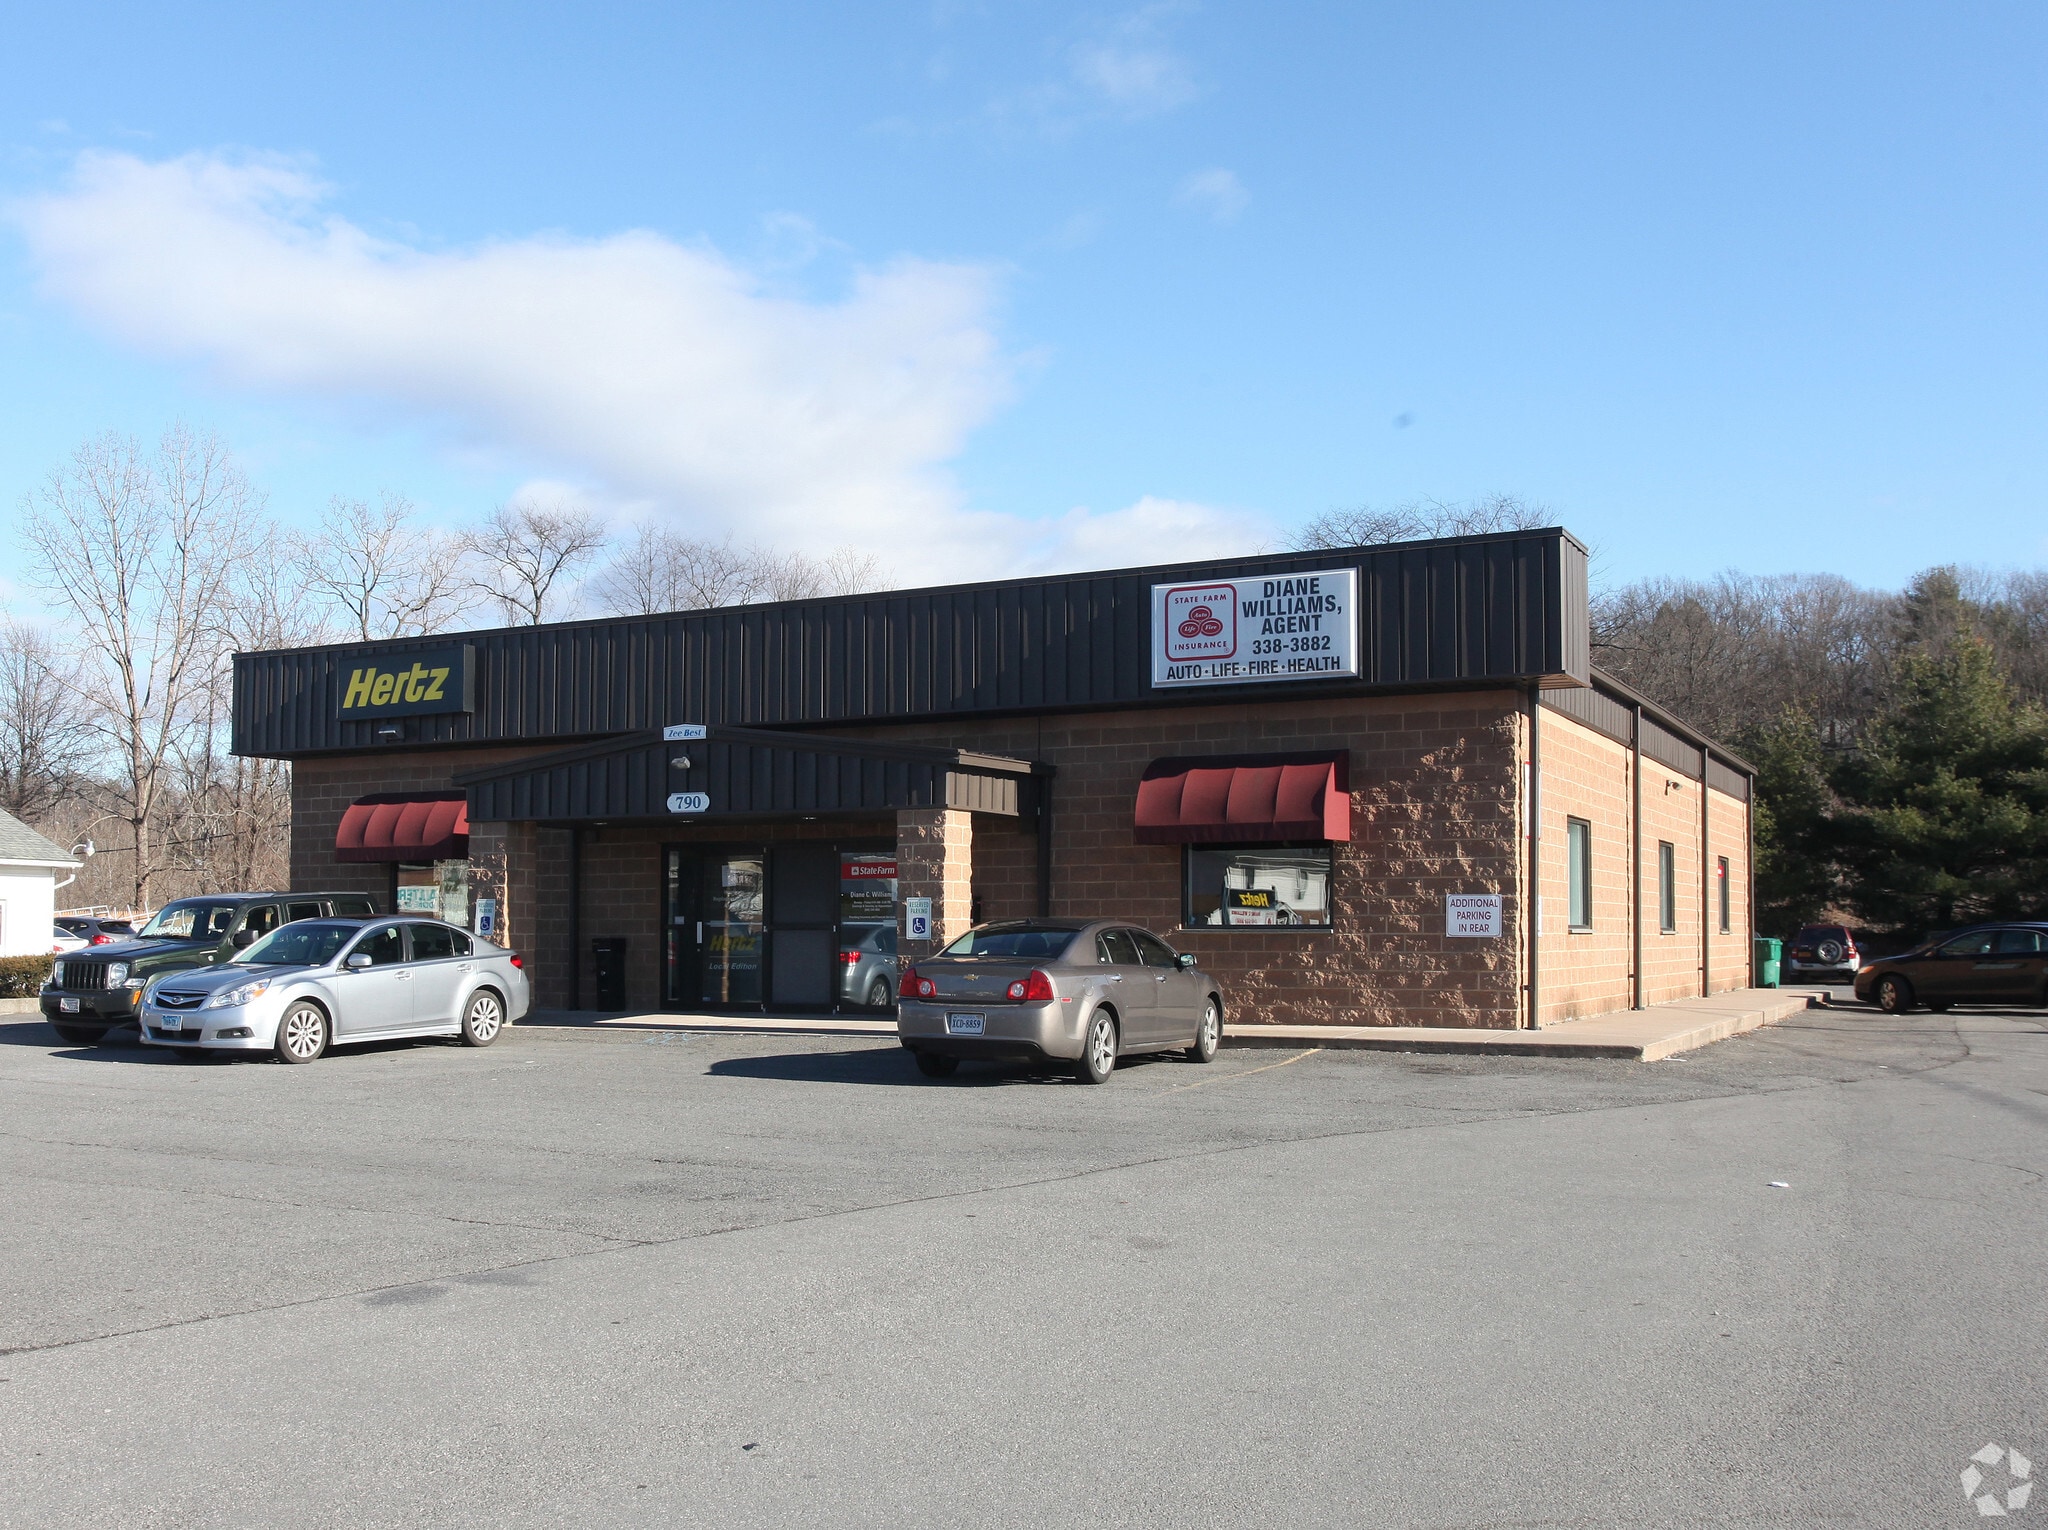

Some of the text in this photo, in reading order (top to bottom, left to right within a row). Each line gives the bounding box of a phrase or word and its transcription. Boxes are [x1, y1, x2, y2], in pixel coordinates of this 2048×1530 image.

[1263, 577, 1320, 598] DIANE
[1174, 593, 1227, 605] STATE FARM
[1242, 594, 1342, 618] WILLIAMS,
[1193, 611, 1208, 619] Auto
[1184, 623, 1218, 634] Life Fire
[1261, 614, 1322, 635] AGENT
[1174, 640, 1228, 651] INSURANCE
[1252, 635, 1331, 655] 338-3882
[1166, 656, 1341, 680] AUTO LIFE FIRE HEALTH
[342, 662, 450, 709] Hertz
[668, 728, 702, 738] Zee Best
[675, 795, 702, 810] 790
[1450, 898, 1498, 908] ADDITIONAL
[1456, 911, 1492, 920] PARKING
[1458, 923, 1490, 932] IN REAR
[730, 962, 758, 970] Edition
[952, 1019, 981, 1029] XCD-8859
